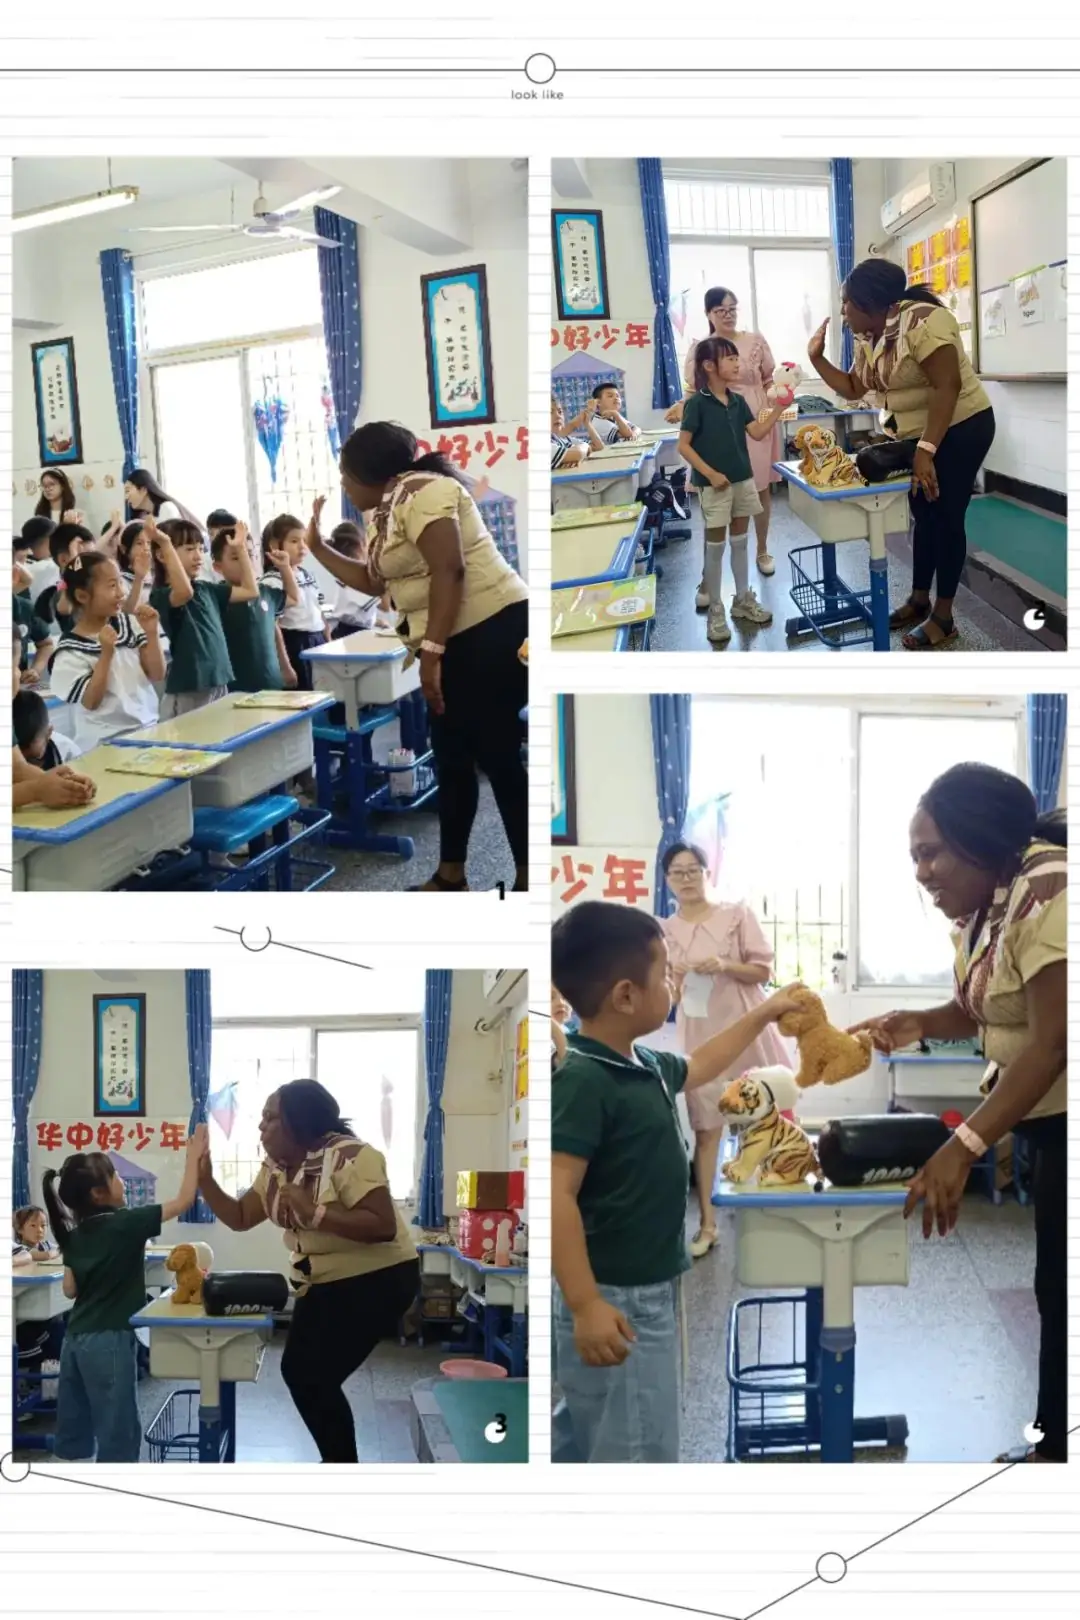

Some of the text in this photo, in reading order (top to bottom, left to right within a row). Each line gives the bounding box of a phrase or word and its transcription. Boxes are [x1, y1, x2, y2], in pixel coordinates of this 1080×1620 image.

[36, 1121, 187, 1151] 华中好少年
